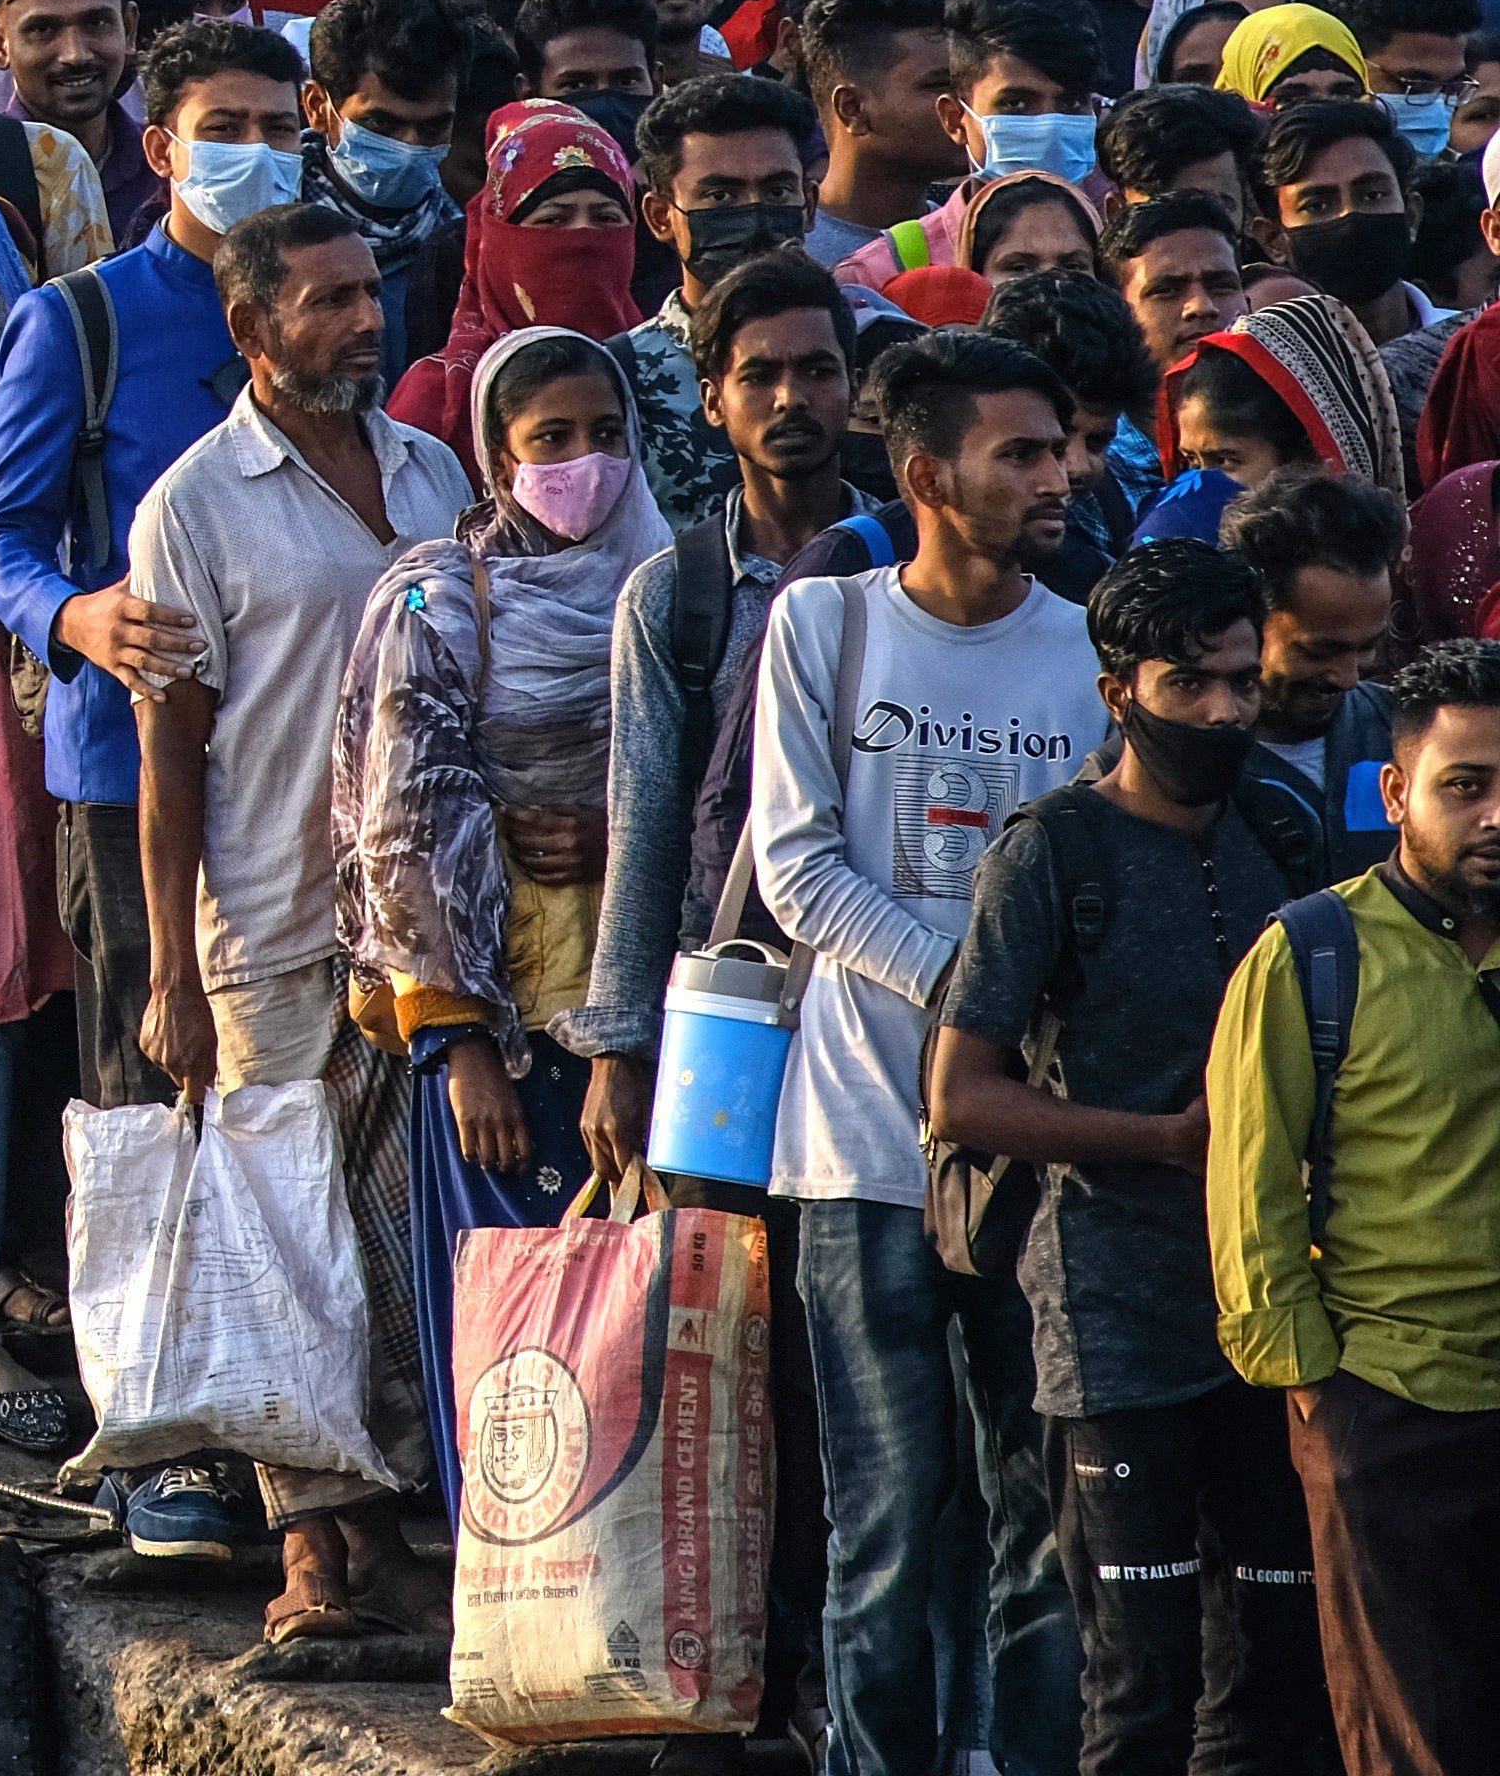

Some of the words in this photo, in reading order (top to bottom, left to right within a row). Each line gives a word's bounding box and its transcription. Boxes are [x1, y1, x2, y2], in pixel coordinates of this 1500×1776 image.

[851, 699, 1073, 762] Division
[691, 1230, 707, 1251] KG
[690, 1251, 706, 1272] 50
[676, 1371, 699, 1470] CEMENT
[515, 1424, 584, 1536] CEMENT
[677, 1474, 698, 1558] BRAND
[1123, 1564, 1149, 1581] IT'S
[1149, 1563, 1172, 1580] ALL
[1257, 1569, 1295, 1584] GOOD!
[1297, 1570, 1316, 1585] IT'
[677, 1563, 699, 1622] KING
[624, 1657, 641, 1669] KG
